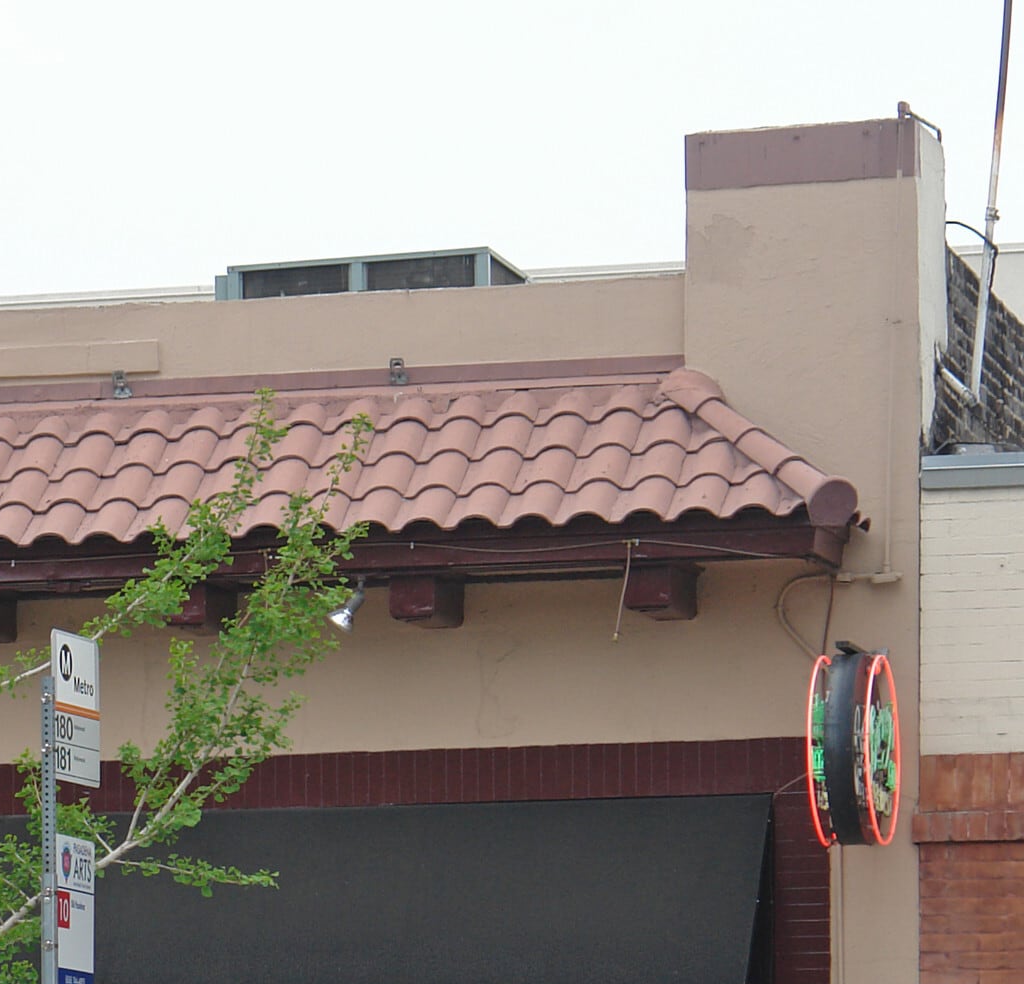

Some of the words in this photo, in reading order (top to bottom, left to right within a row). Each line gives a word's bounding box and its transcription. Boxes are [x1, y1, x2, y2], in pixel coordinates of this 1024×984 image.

[73, 676, 94, 697] Metro
[55, 713, 74, 742] 180
[55, 745, 72, 772] 181
[73, 857, 92, 883] ARTS
[58, 898, 70, 922] 10
